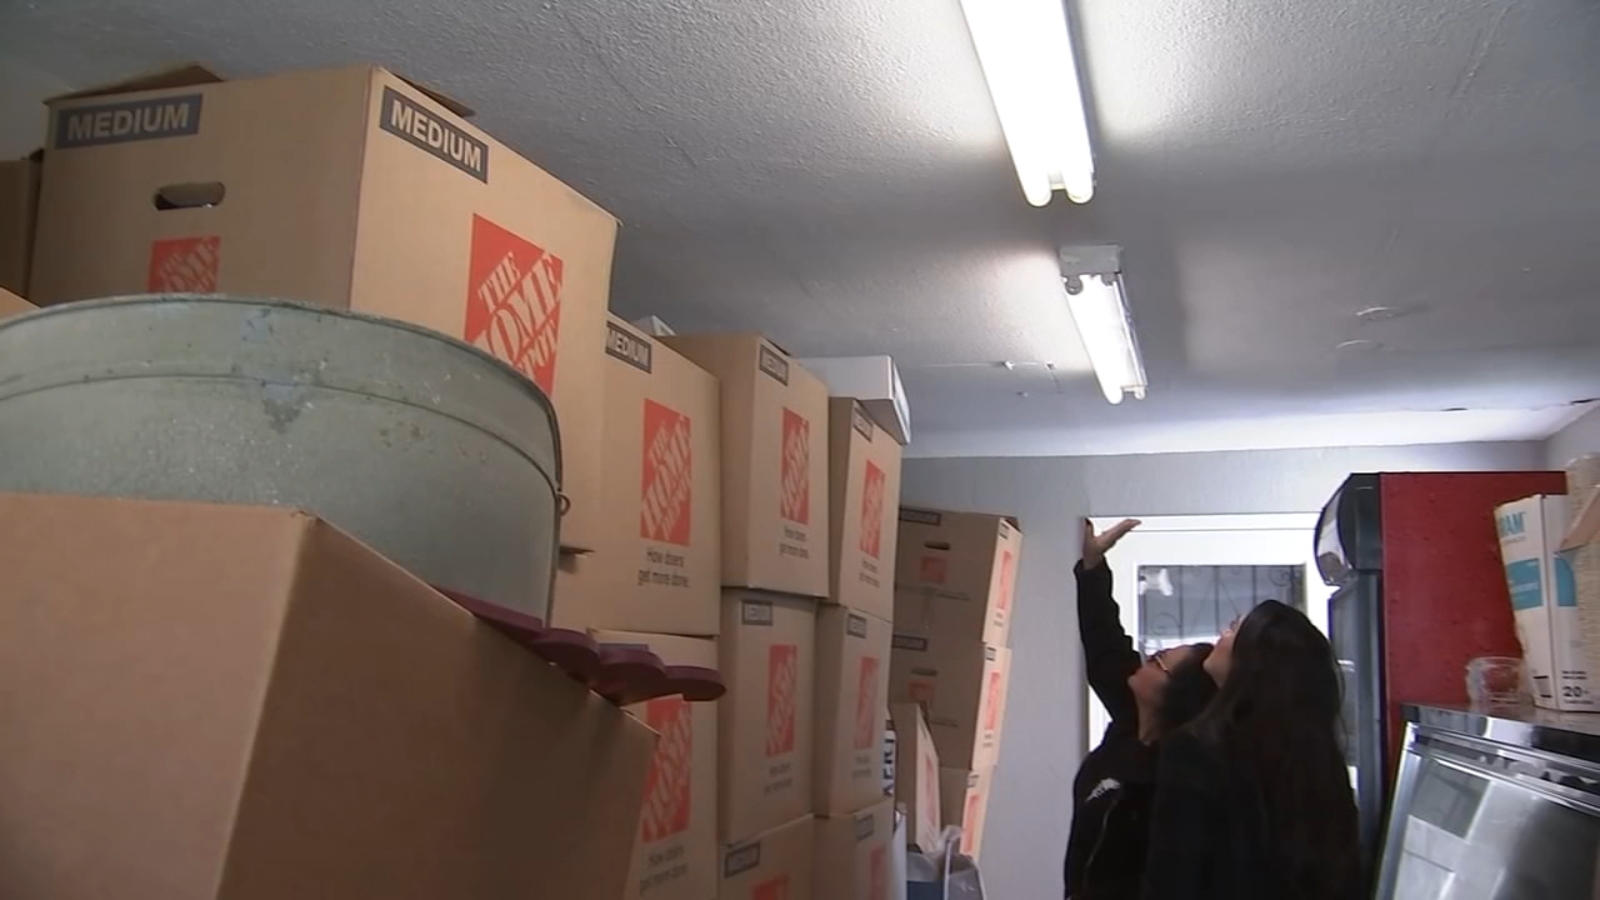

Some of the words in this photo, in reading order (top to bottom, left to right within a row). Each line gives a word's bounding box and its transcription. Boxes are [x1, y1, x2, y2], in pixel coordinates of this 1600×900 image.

[66, 102, 190, 141] MEDIUM
[391, 98, 482, 173] MEDIUM
[478, 250, 521, 313] THE
